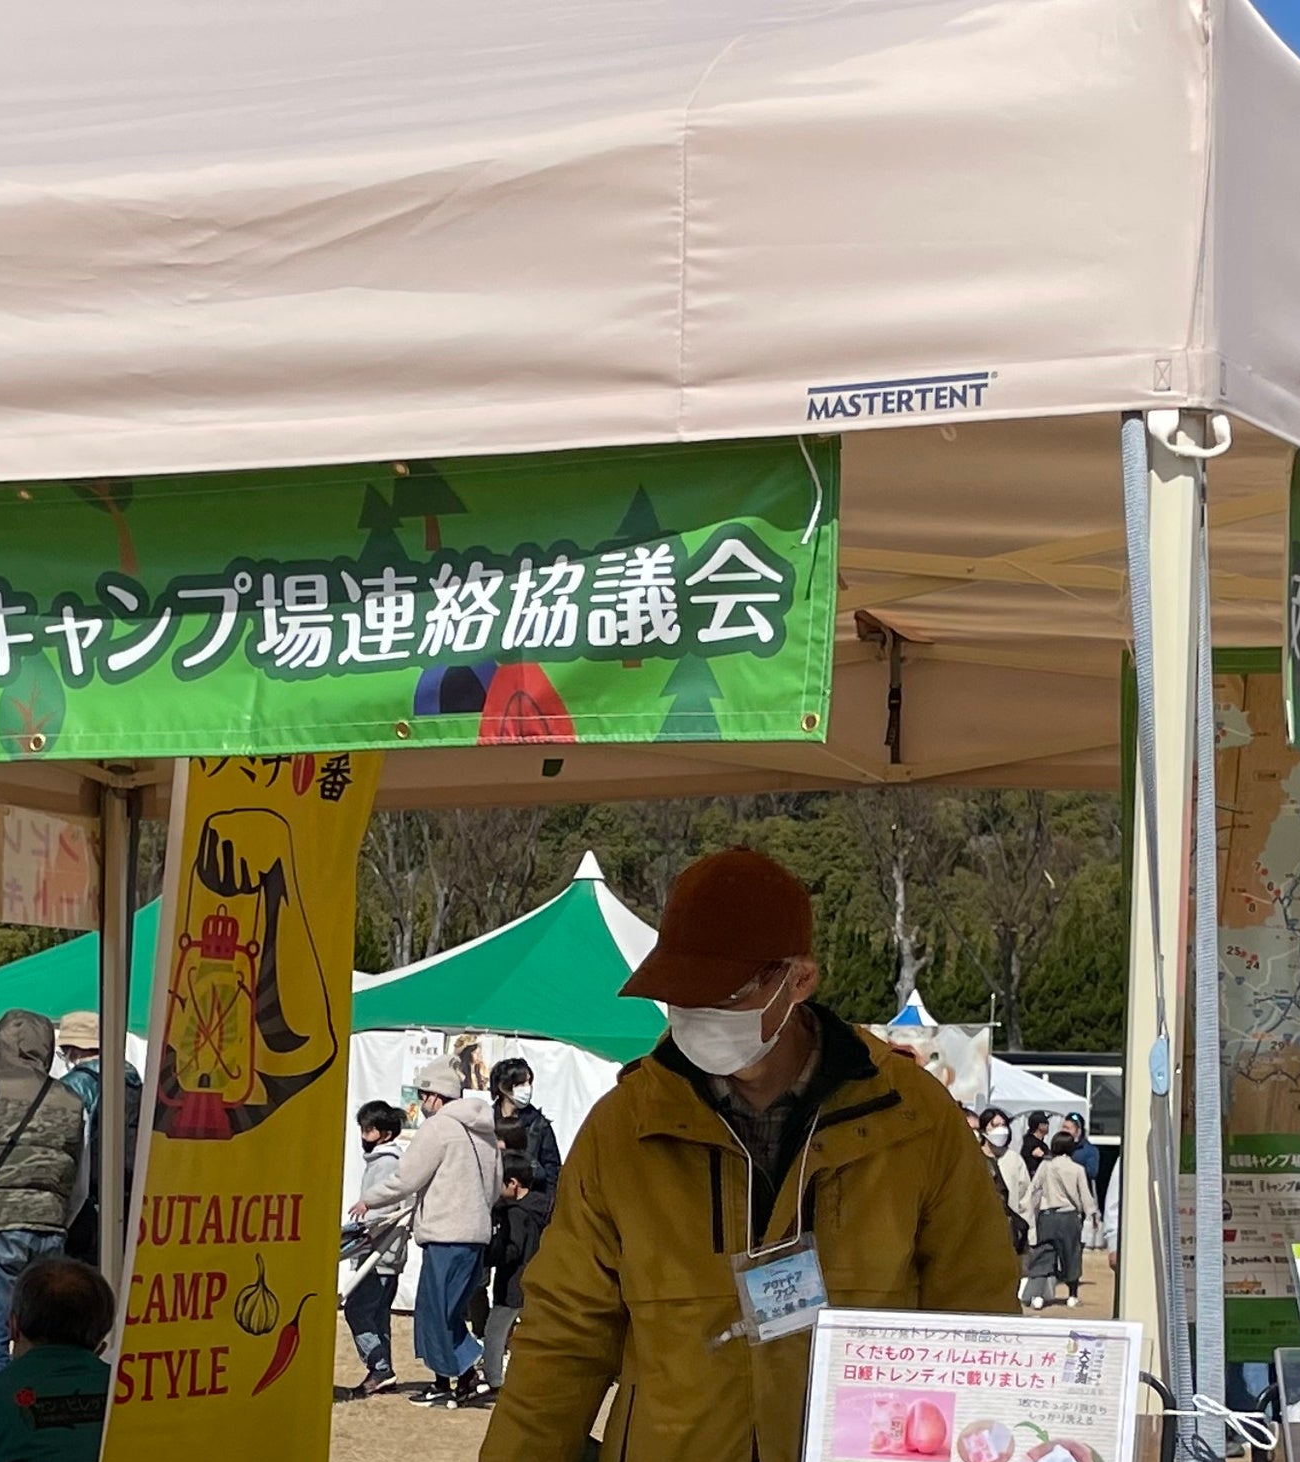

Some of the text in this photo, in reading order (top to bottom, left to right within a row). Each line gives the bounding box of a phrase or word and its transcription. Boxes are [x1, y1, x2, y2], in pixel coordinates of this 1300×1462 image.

[806, 381, 988, 421] MASTERTENT
[316, 753, 353, 802] 番
[125, 1271, 228, 1325] CAMP
[114, 1345, 230, 1404] STYLE
